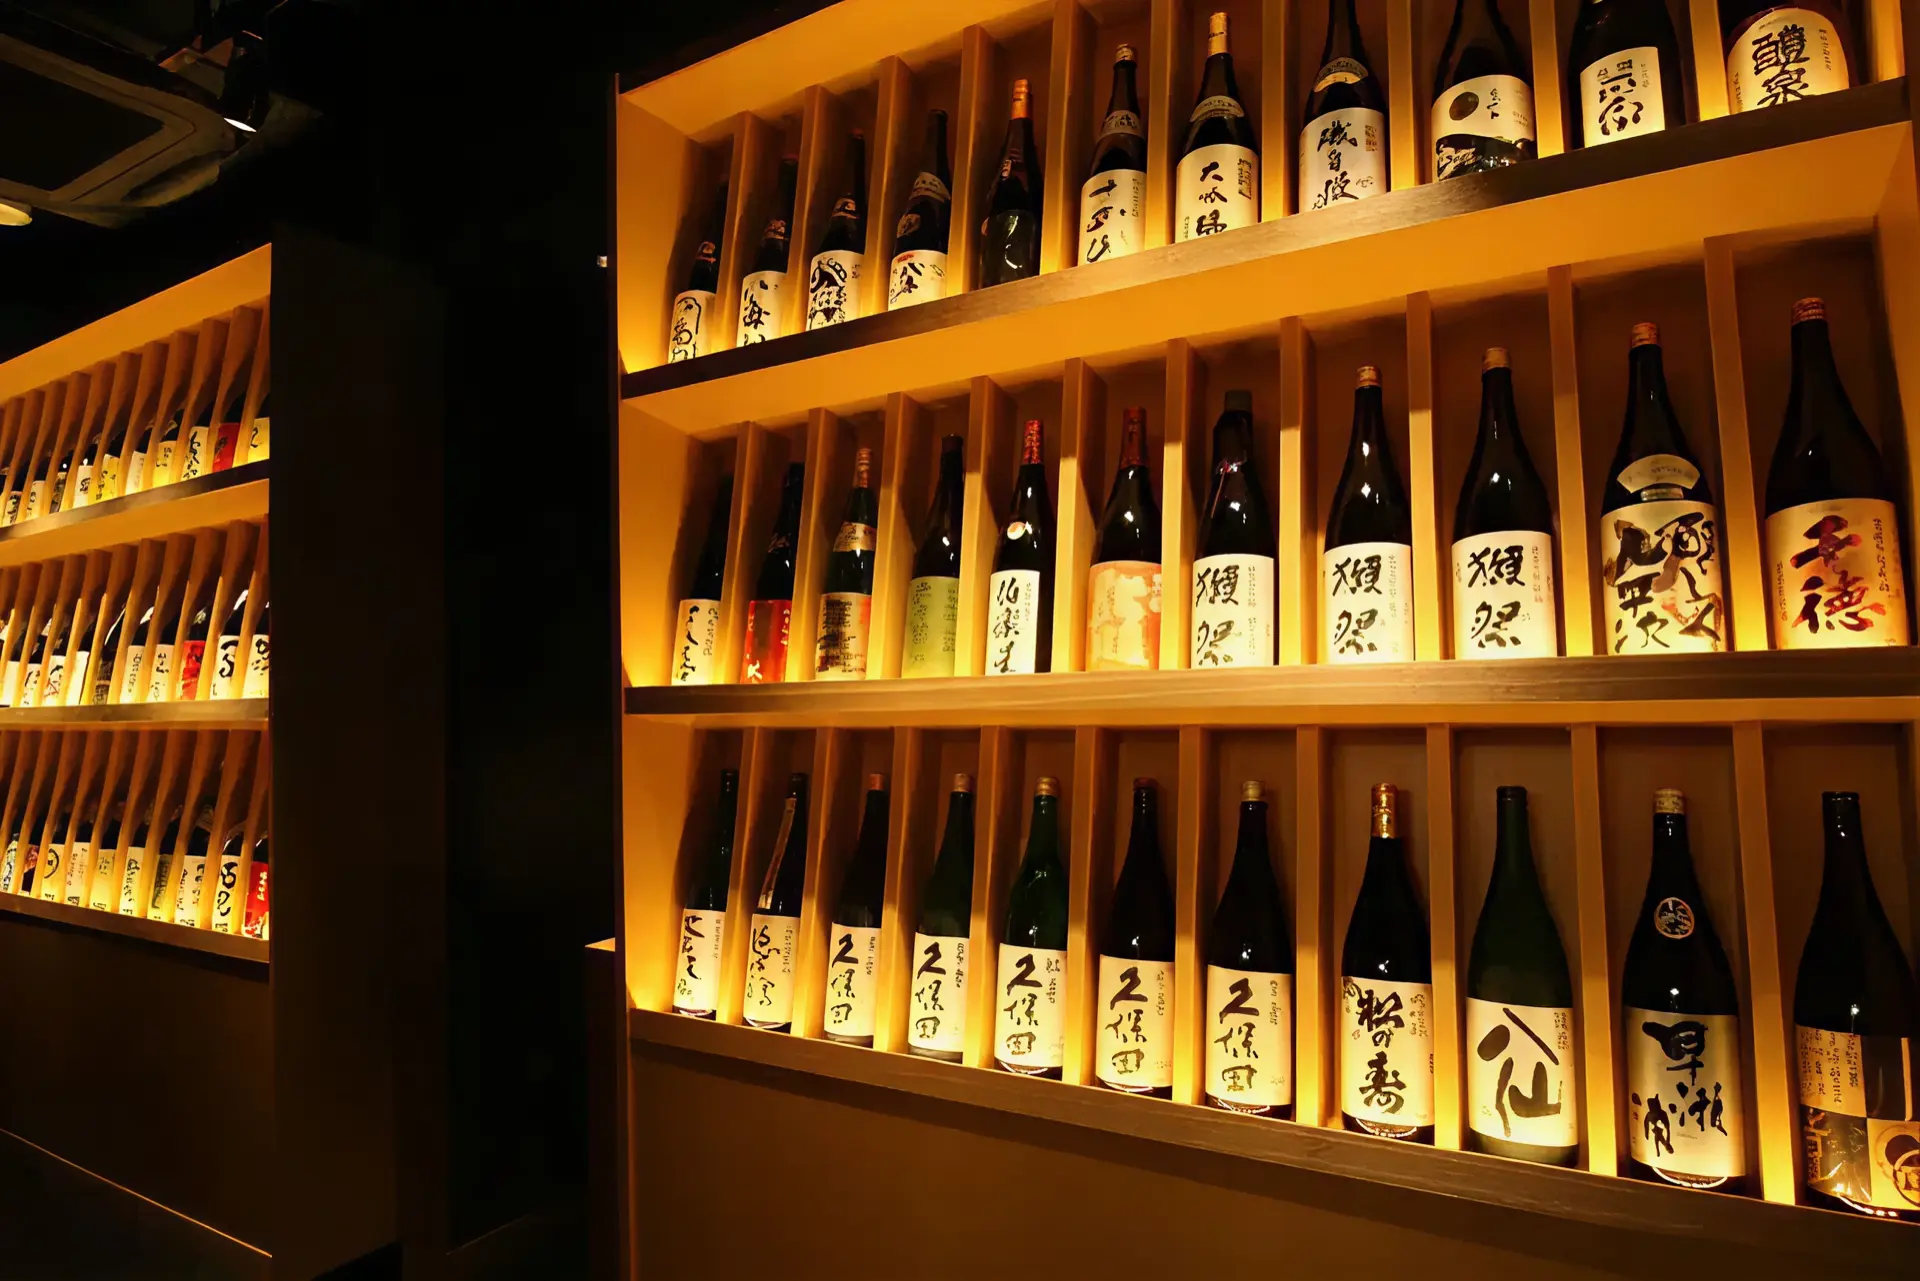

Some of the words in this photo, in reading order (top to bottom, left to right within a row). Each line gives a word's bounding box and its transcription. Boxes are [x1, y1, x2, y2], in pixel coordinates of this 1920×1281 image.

[1750, 23, 1809, 106] 醴泉
[1195, 565, 1240, 667] 獺祭
[1332, 553, 1383, 656] 獺祭
[1468, 545, 1527, 649] 獺祭
[1789, 515, 1887, 634] 千徳
[831, 933, 859, 1025] 久保田
[914, 941, 946, 1039] 久保田
[1003, 953, 1043, 1056] 久保田
[1105, 966, 1149, 1075] 久保田
[1213, 977, 1260, 1092] 久保田
[1355, 989, 1406, 1115] 松の寿
[1476, 1007, 1562, 1138] 八仙
